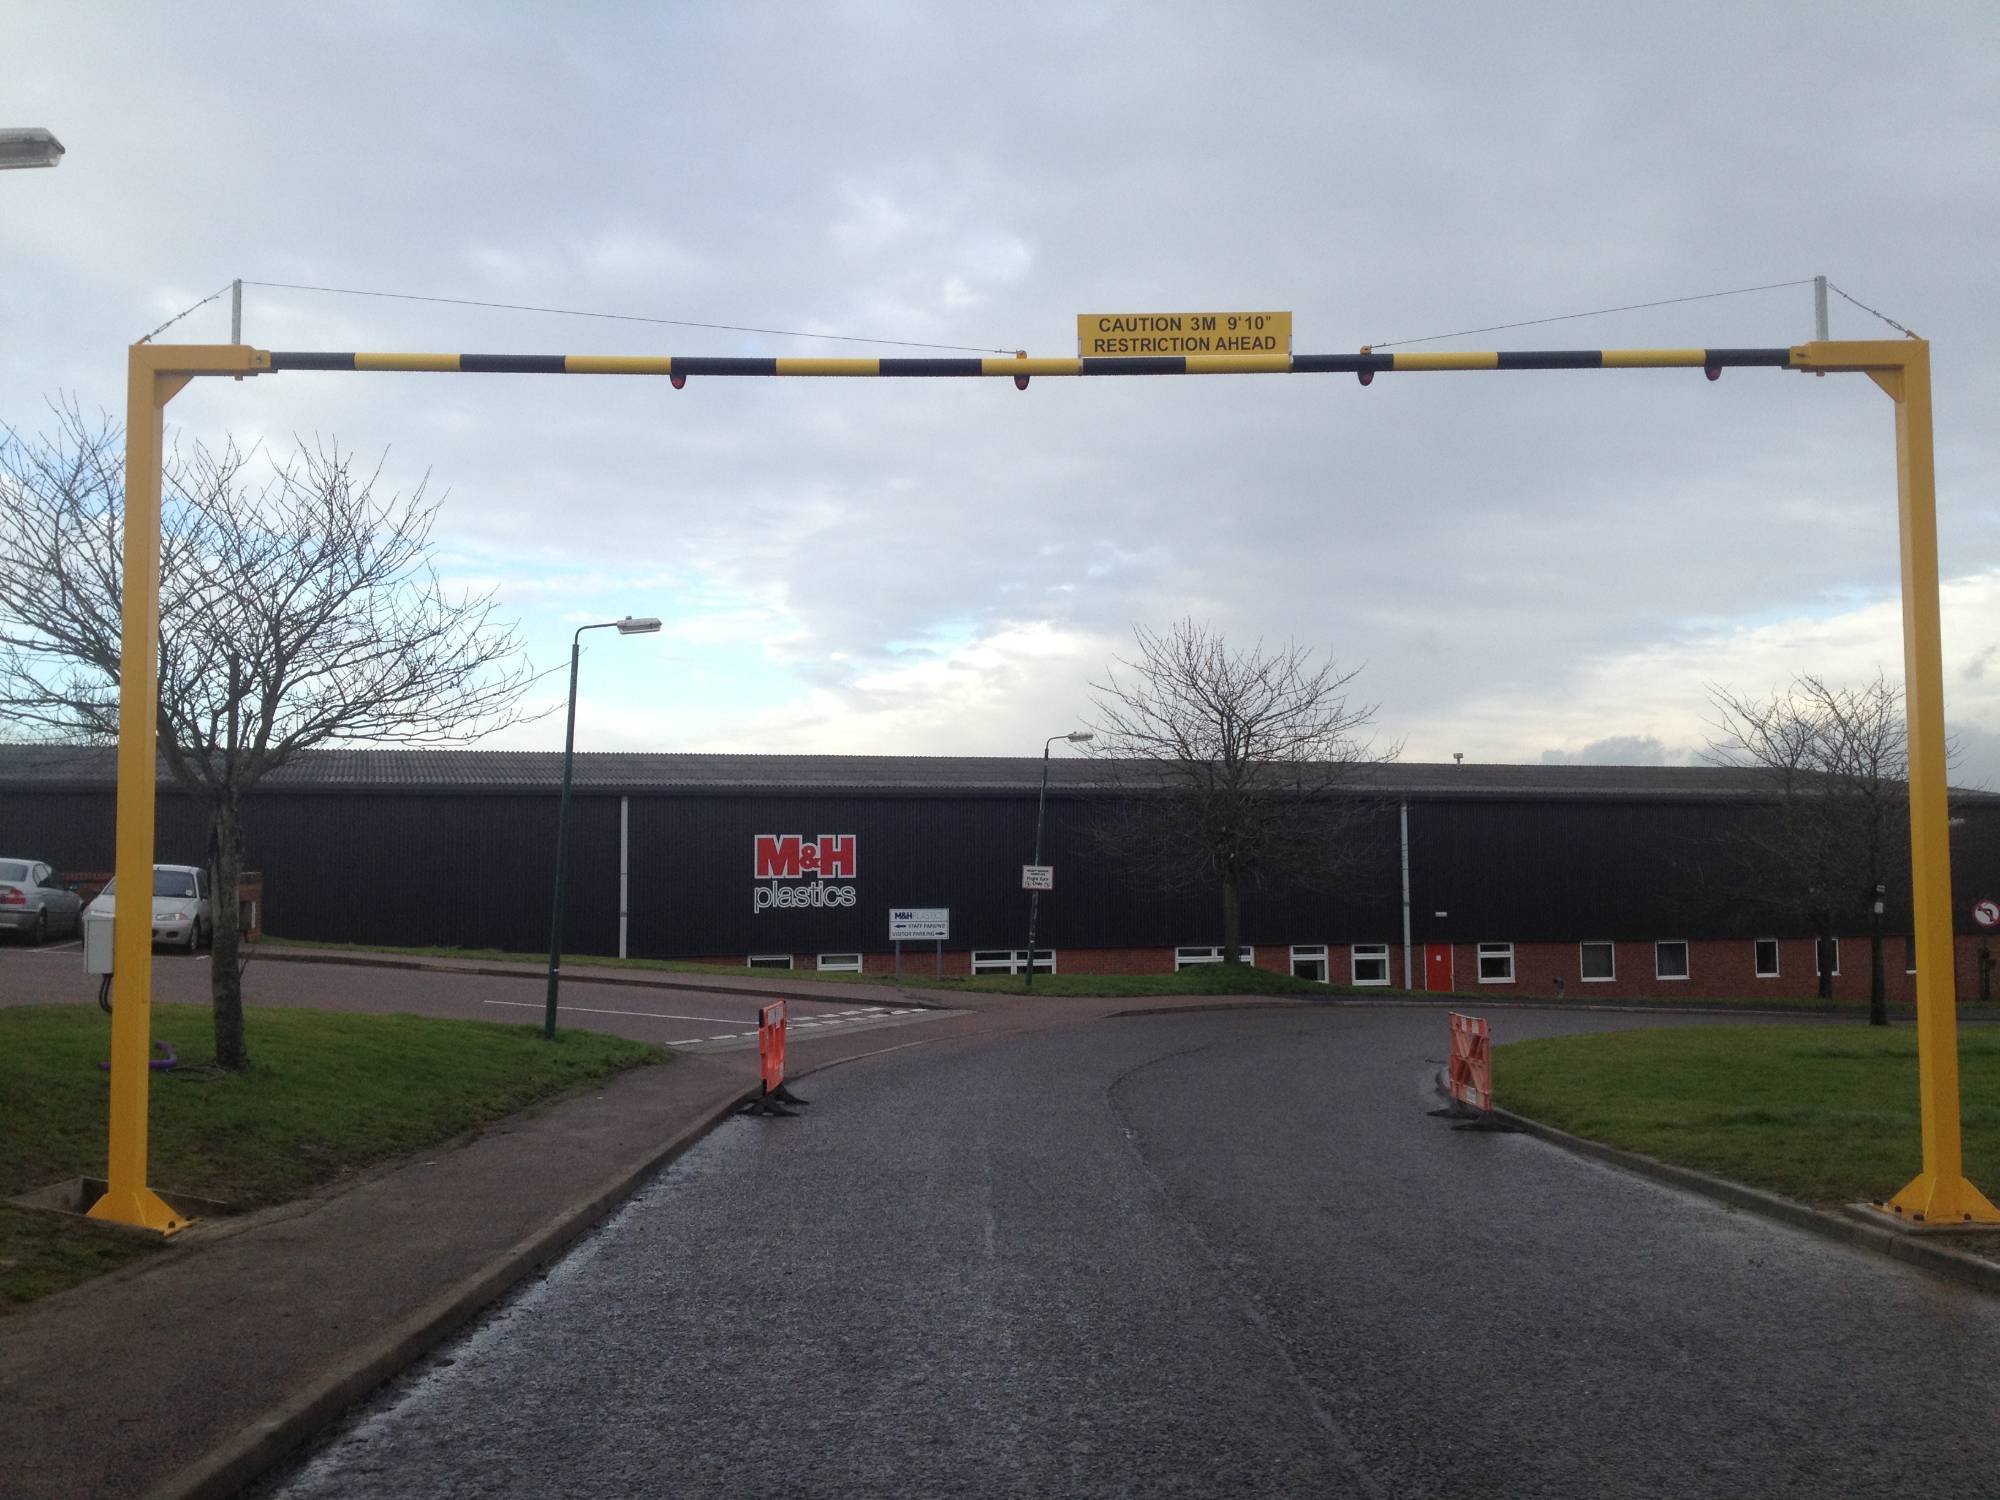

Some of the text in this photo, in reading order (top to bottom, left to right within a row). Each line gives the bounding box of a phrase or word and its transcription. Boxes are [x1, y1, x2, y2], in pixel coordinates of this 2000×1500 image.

[1099, 317, 1181, 332] CAUTION
[1191, 316, 1216, 331] 3M
[1094, 336, 1276, 352] RESTRICTION AHEAD
[754, 834, 857, 879] M&H
[754, 880, 857, 914] plastics
[894, 911, 913, 920] M&H
